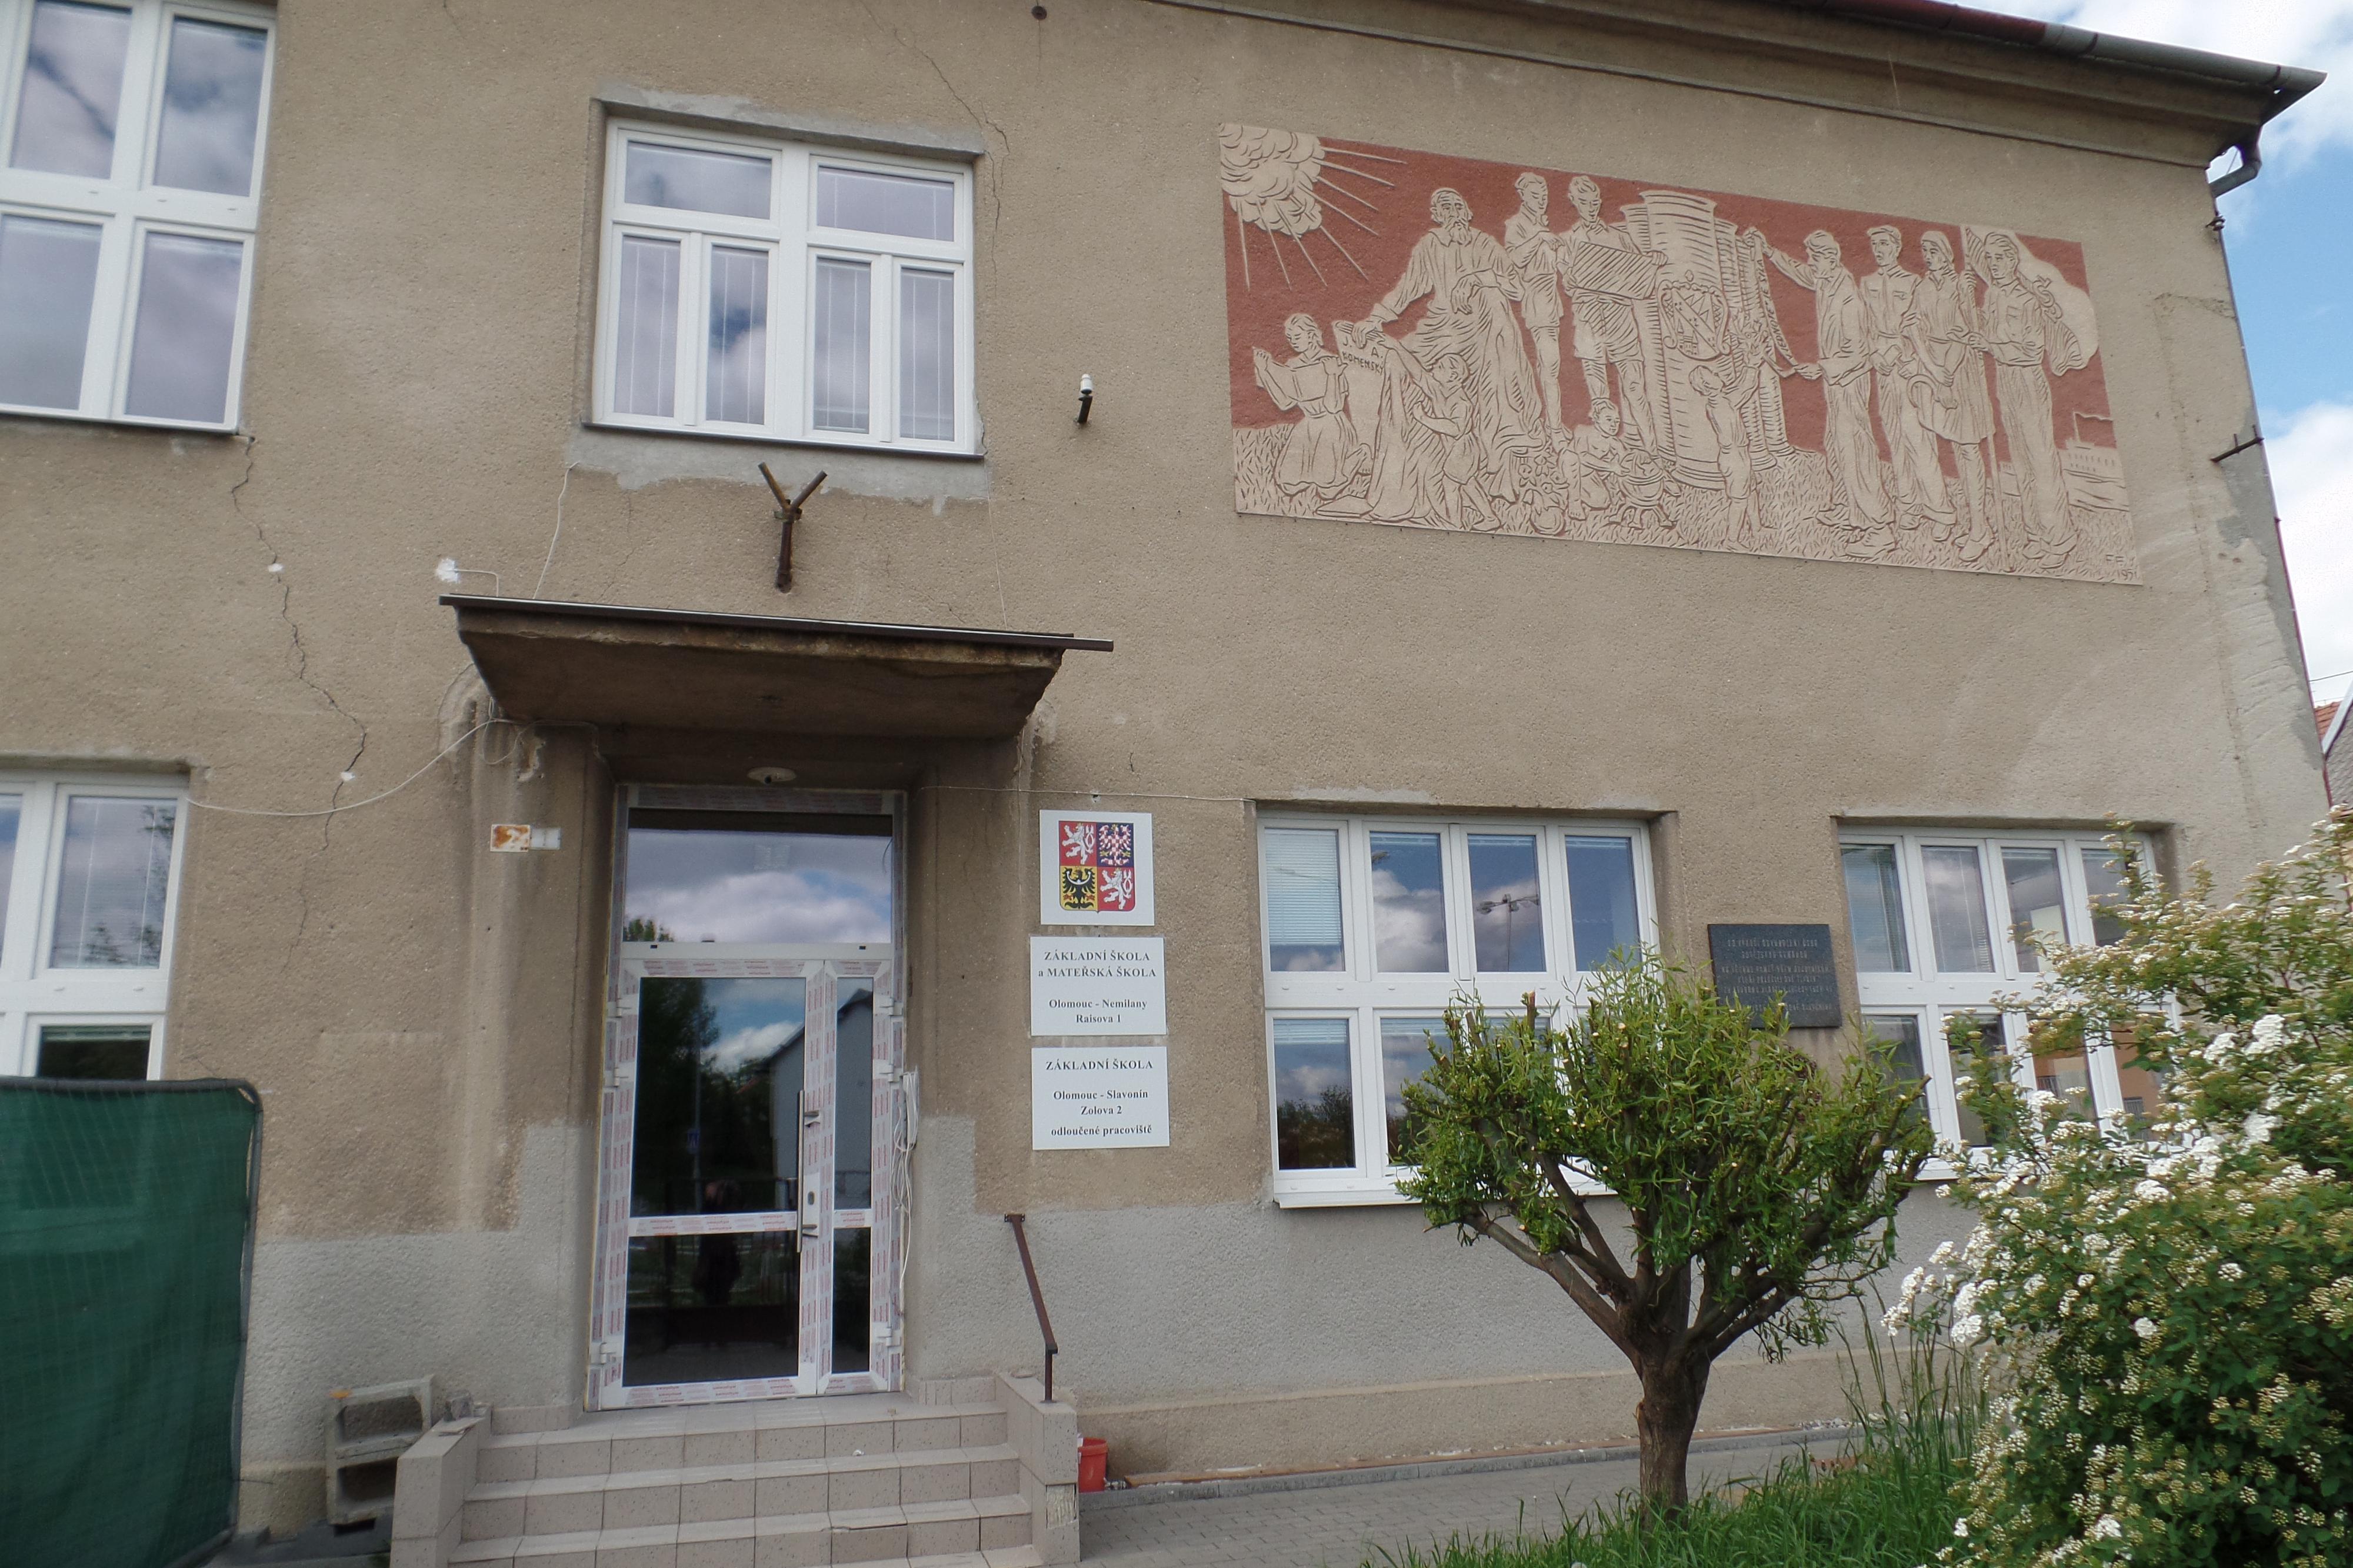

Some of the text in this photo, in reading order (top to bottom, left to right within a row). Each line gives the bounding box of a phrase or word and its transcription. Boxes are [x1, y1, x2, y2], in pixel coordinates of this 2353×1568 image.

[1342, 336, 1383, 358] J. A.
[1044, 949, 1150, 961] ZÁKLADNÍ ŠKOLA
[1047, 966, 1113, 977] MATEŘSKÁ
[1116, 966, 1156, 977] ŠKOLA
[1049, 999, 1092, 1008] Olomouc
[1102, 999, 1147, 1010] Nemilany
[1076, 1014, 1121, 1023] Raisova 1
[1046, 1058, 1153, 1070] ZÁKLADNÍ ŠKOLA
[1054, 1090, 1098, 1100] Olomouc
[1106, 1089, 1148, 1099] Slavonín
[1081, 1105, 1122, 1115] Zolova 2
[1051, 1125, 1152, 1137] odloučené pracoviště
